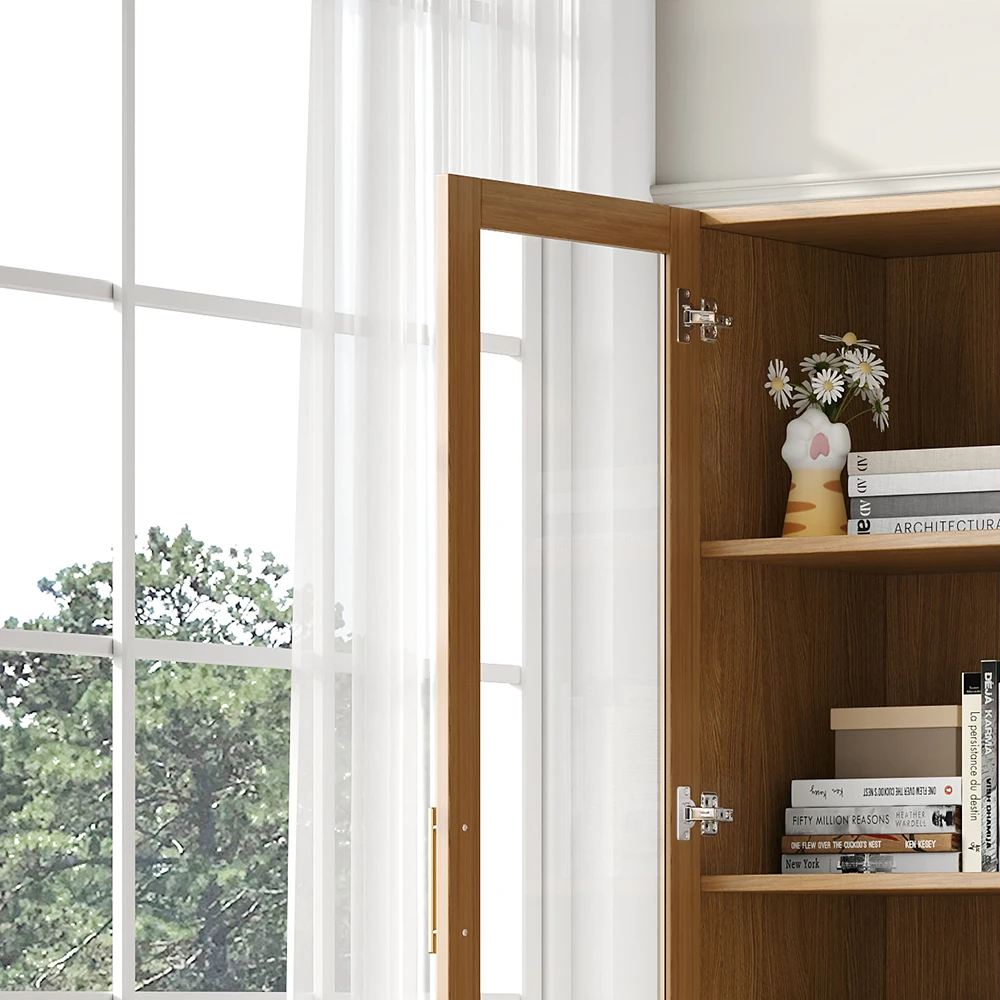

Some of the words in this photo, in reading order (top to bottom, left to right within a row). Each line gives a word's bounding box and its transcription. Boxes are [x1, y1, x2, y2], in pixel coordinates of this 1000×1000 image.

[857, 455, 868, 472] AD
[857, 478, 867, 494] AD
[859, 499, 871, 517] AD
[970, 712, 980, 722] La
[984, 710, 993, 755] KARMA
[968, 724, 980, 777] persistance
[928, 786, 936, 796] ONE
[970, 780, 980, 792] du
[862, 788, 874, 797] NEST
[904, 787, 916, 796] OVER
[970, 794, 980, 821] destin
[792, 815, 814, 826] FIFTY
[816, 815, 850, 826] MILLION
[852, 814, 890, 825] REASONS
[895, 810, 926, 820] HEATHER
[895, 819, 927, 828] WARDELL
[791, 841, 801, 850] ONE
[802, 841, 816, 849] FLEW
[818, 841, 831, 849] OVER
[832, 840, 843, 849] THE
[868, 840, 882, 848] NEST
[904, 840, 916, 848] KEN
[917, 840, 937, 848] KESEY
[785, 859, 802, 868] New
[802, 858, 820, 868] York
